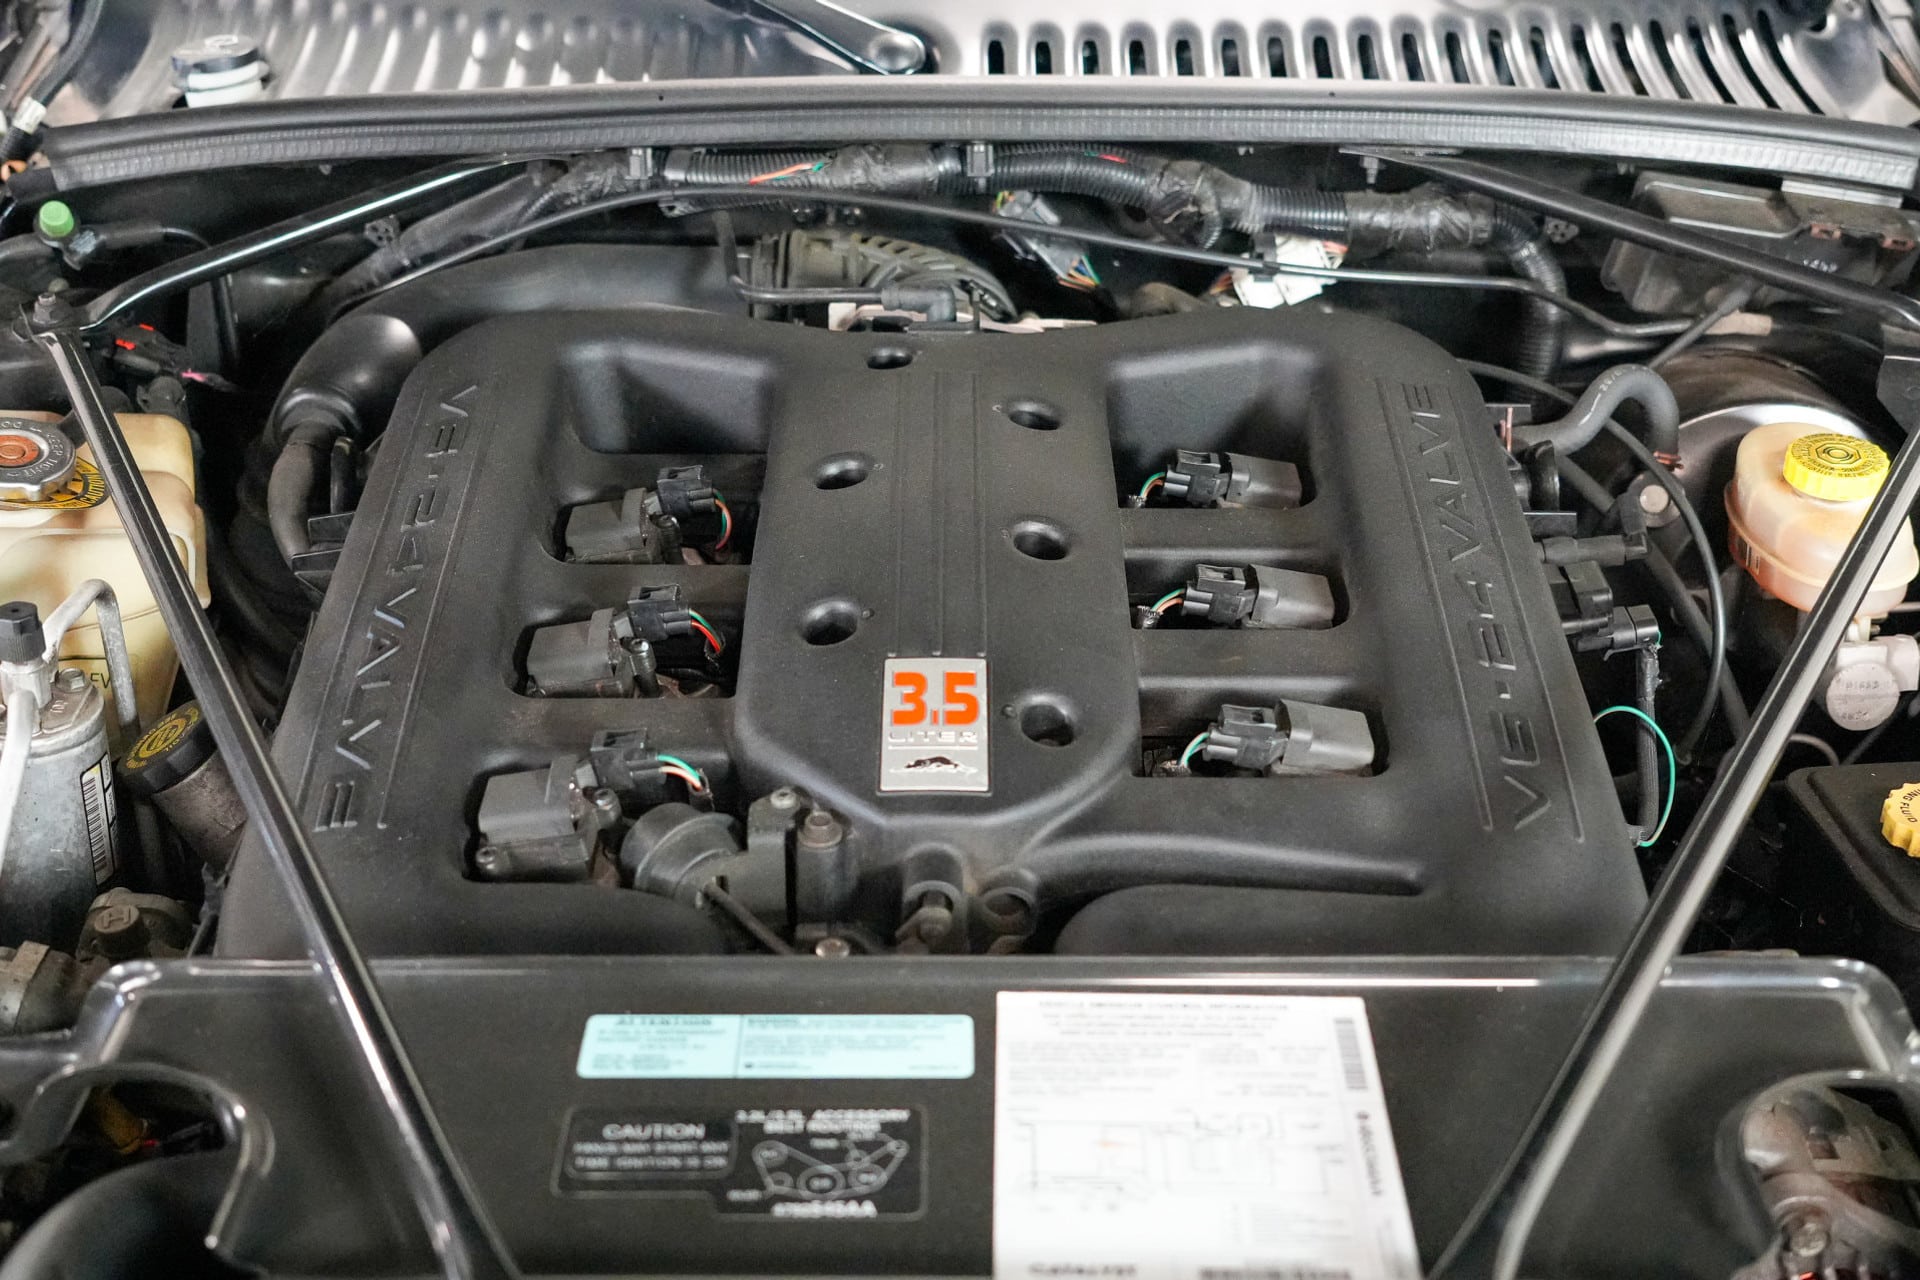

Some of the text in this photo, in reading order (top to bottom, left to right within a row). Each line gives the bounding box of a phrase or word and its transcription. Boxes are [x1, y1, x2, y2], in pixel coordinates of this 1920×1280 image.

[1401, 382, 1482, 562] VALVE
[81, 475, 105, 504] CAUTION
[313, 587, 417, 832] VALVE
[891, 671, 980, 726] 3.5
[888, 730, 978, 743] LITER
[1900, 802, 1918, 823] FLUID
[602, 1122, 706, 1140] CAUTION
